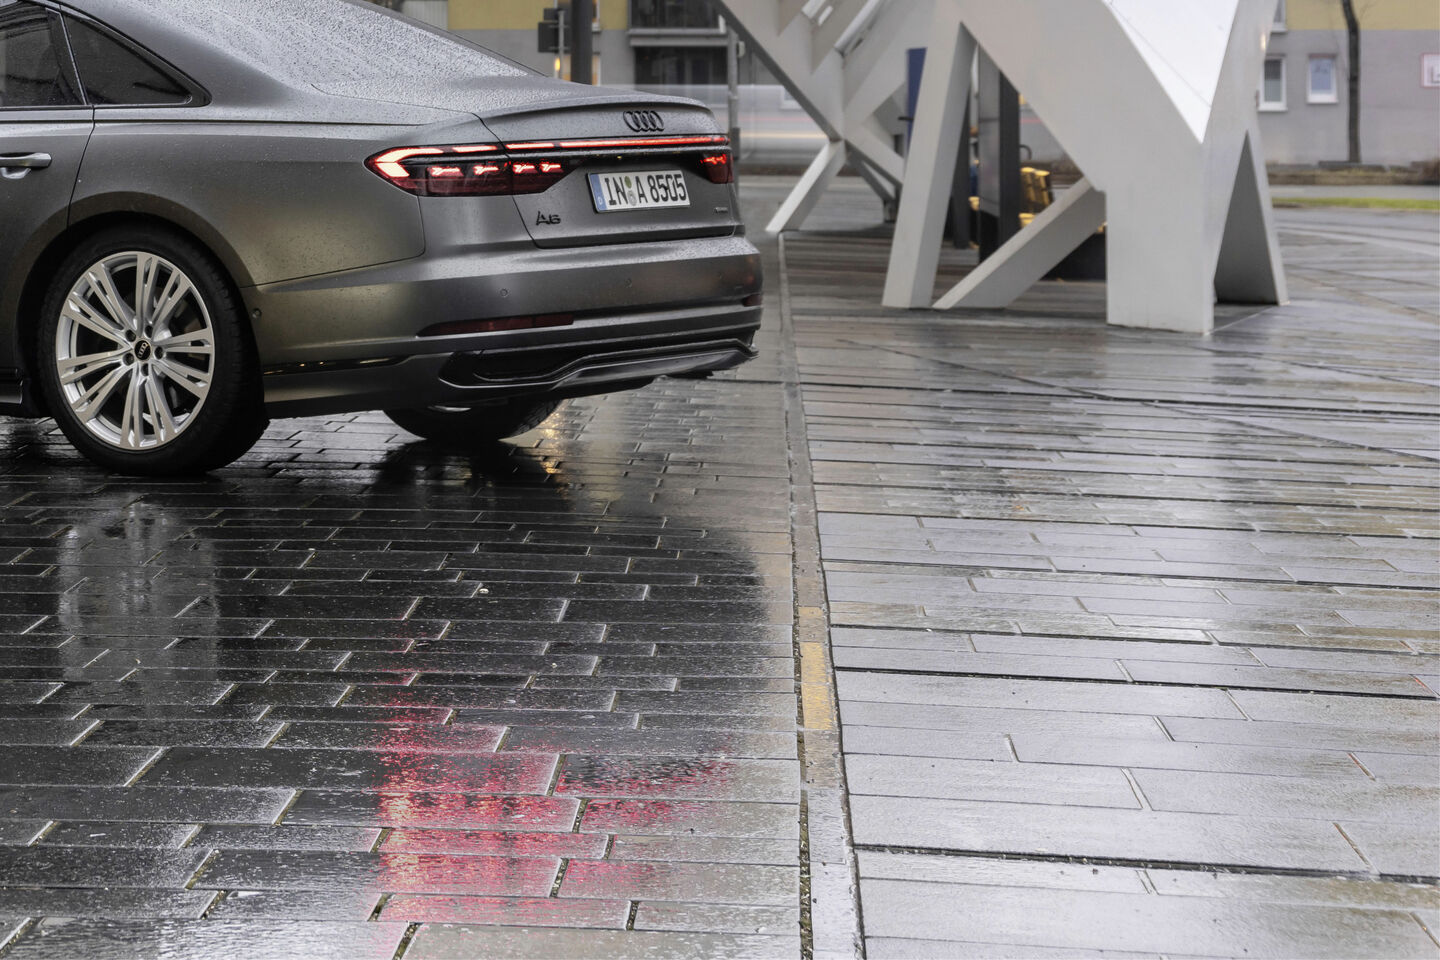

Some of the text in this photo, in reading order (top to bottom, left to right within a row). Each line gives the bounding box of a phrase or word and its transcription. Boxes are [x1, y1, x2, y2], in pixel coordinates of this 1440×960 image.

[604, 174, 687, 206] IN A 8505
